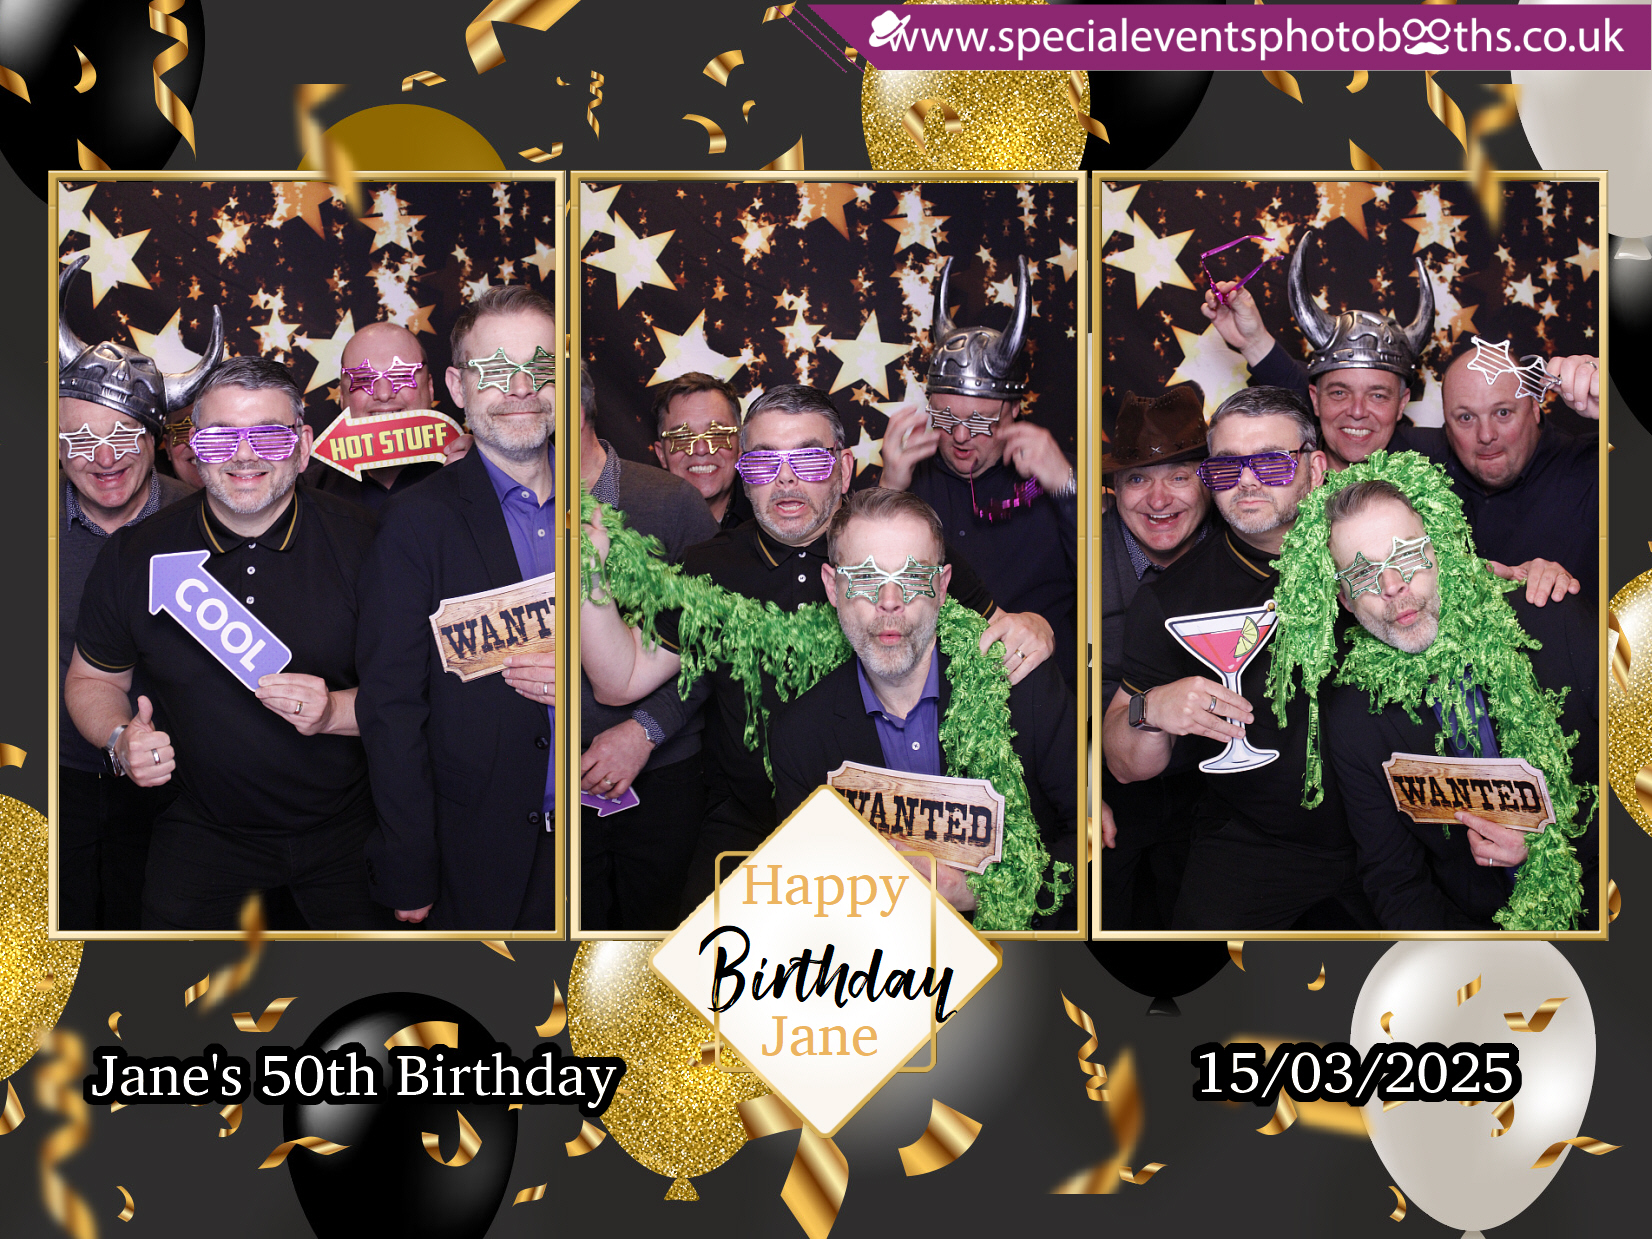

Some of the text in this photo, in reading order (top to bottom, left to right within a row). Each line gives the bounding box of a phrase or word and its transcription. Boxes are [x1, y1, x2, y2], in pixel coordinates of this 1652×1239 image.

[329, 422, 448, 461] HOT STUFF
[175, 578, 267, 672] COOL
[441, 597, 555, 659] WANT
[1393, 775, 1542, 813] WANTED
